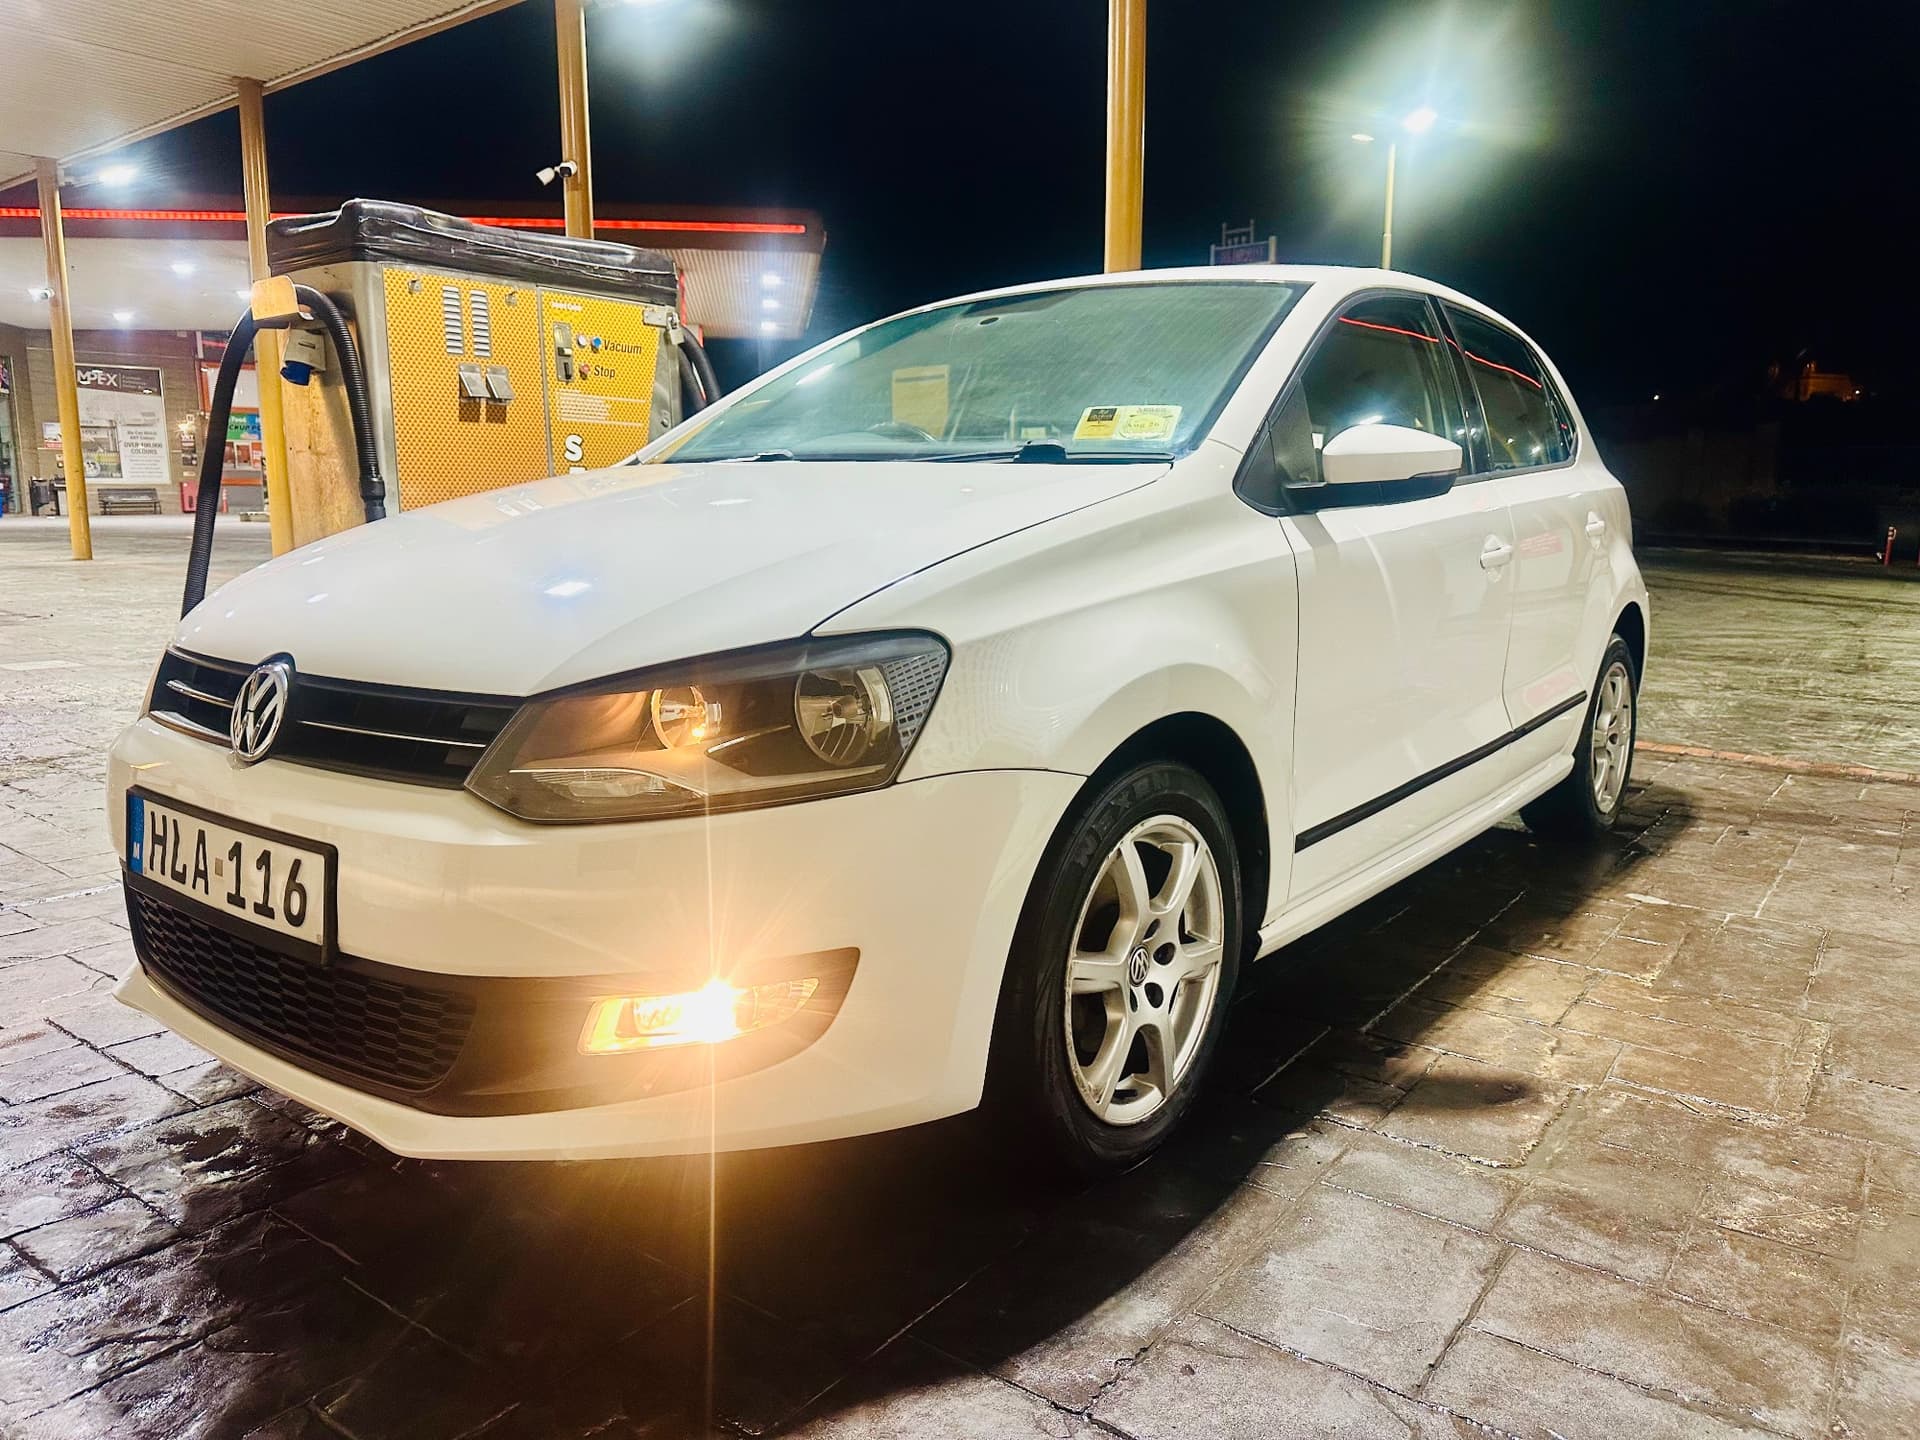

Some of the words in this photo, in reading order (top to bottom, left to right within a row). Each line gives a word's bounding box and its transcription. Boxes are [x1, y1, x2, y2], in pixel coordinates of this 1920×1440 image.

[604, 339, 642, 355] Vacuum
[594, 364, 616, 379] Stop
[563, 433, 586, 473] S
[150, 810, 209, 896] HLA
[226, 840, 308, 928] 116
